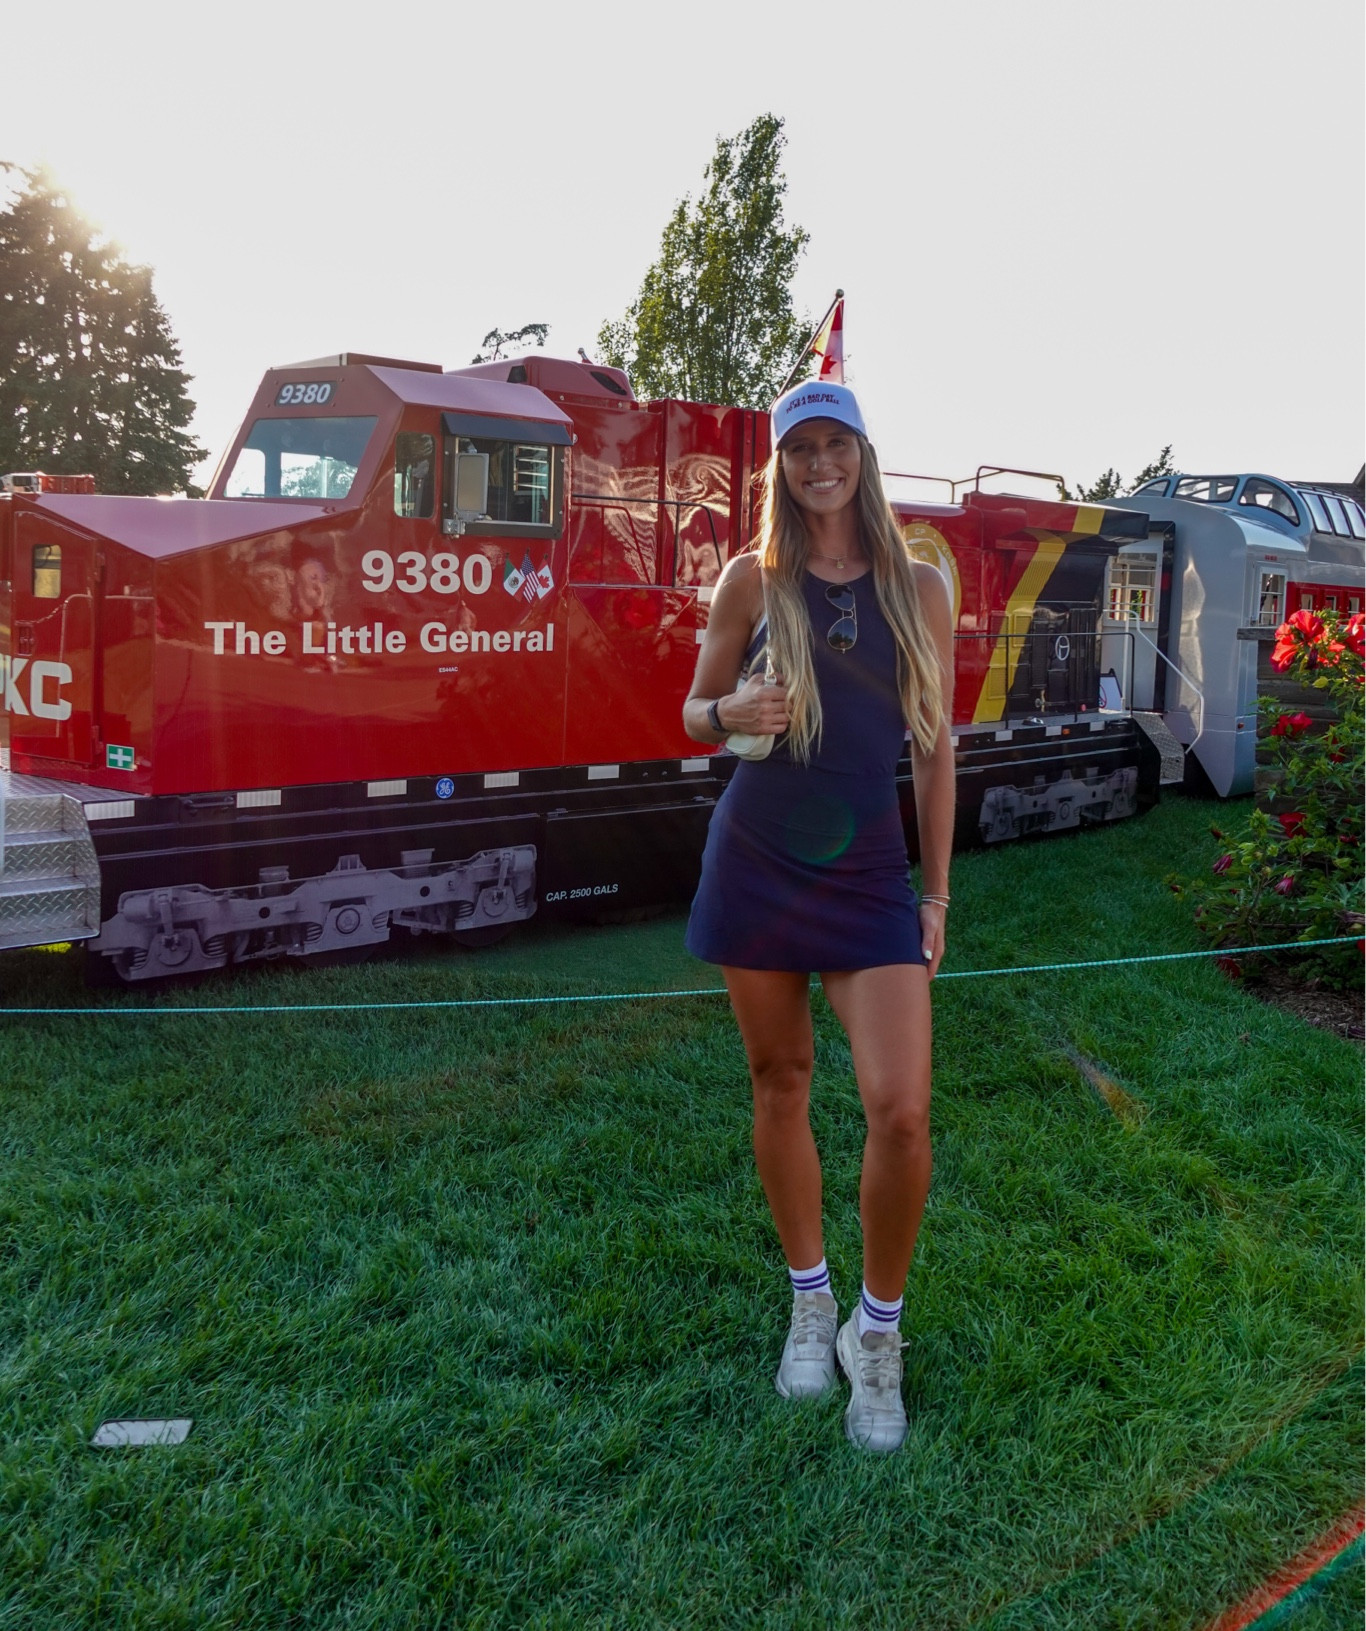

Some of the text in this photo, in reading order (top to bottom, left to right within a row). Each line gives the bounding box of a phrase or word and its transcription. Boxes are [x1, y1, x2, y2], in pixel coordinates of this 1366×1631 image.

[280, 384, 331, 404] 9380
[361, 550, 493, 595] 9380
[204, 621, 555, 655] The Little General
[546, 883, 619, 902] CAP. 2500 GALS
